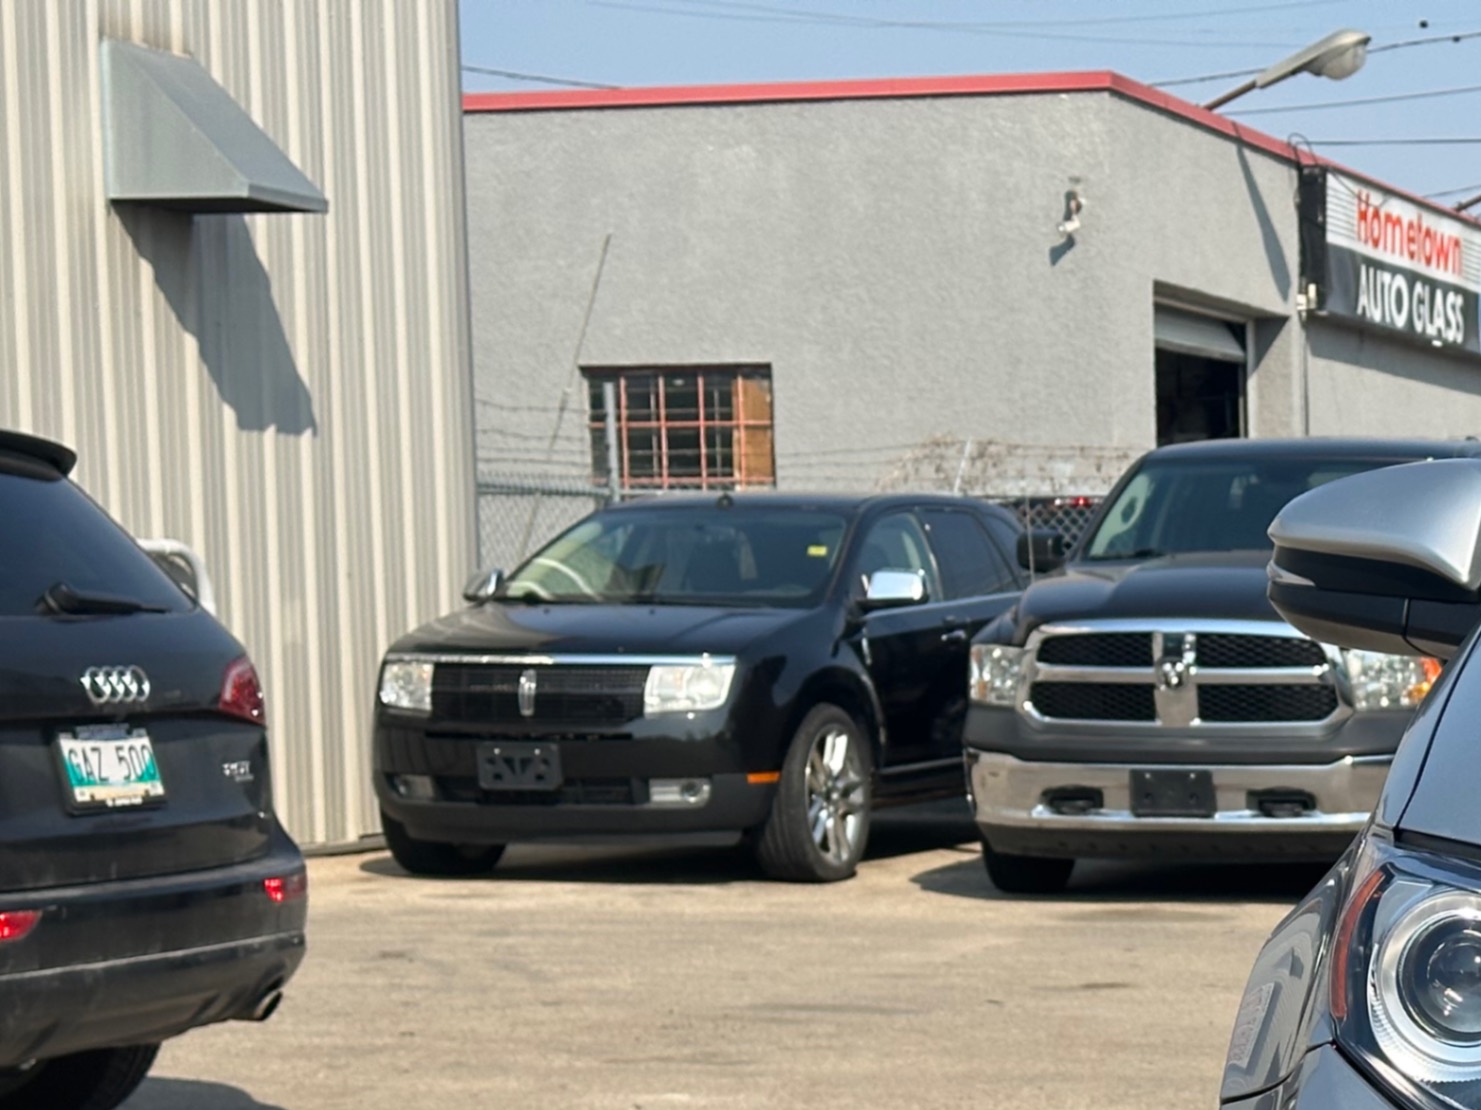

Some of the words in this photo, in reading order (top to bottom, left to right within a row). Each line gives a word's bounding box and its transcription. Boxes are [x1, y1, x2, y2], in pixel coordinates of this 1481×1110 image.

[1357, 189, 1463, 276] Hometown
[1357, 264, 1409, 328] AUTO
[1412, 280, 1464, 345] GLASS
[115, 744, 158, 781] 500
